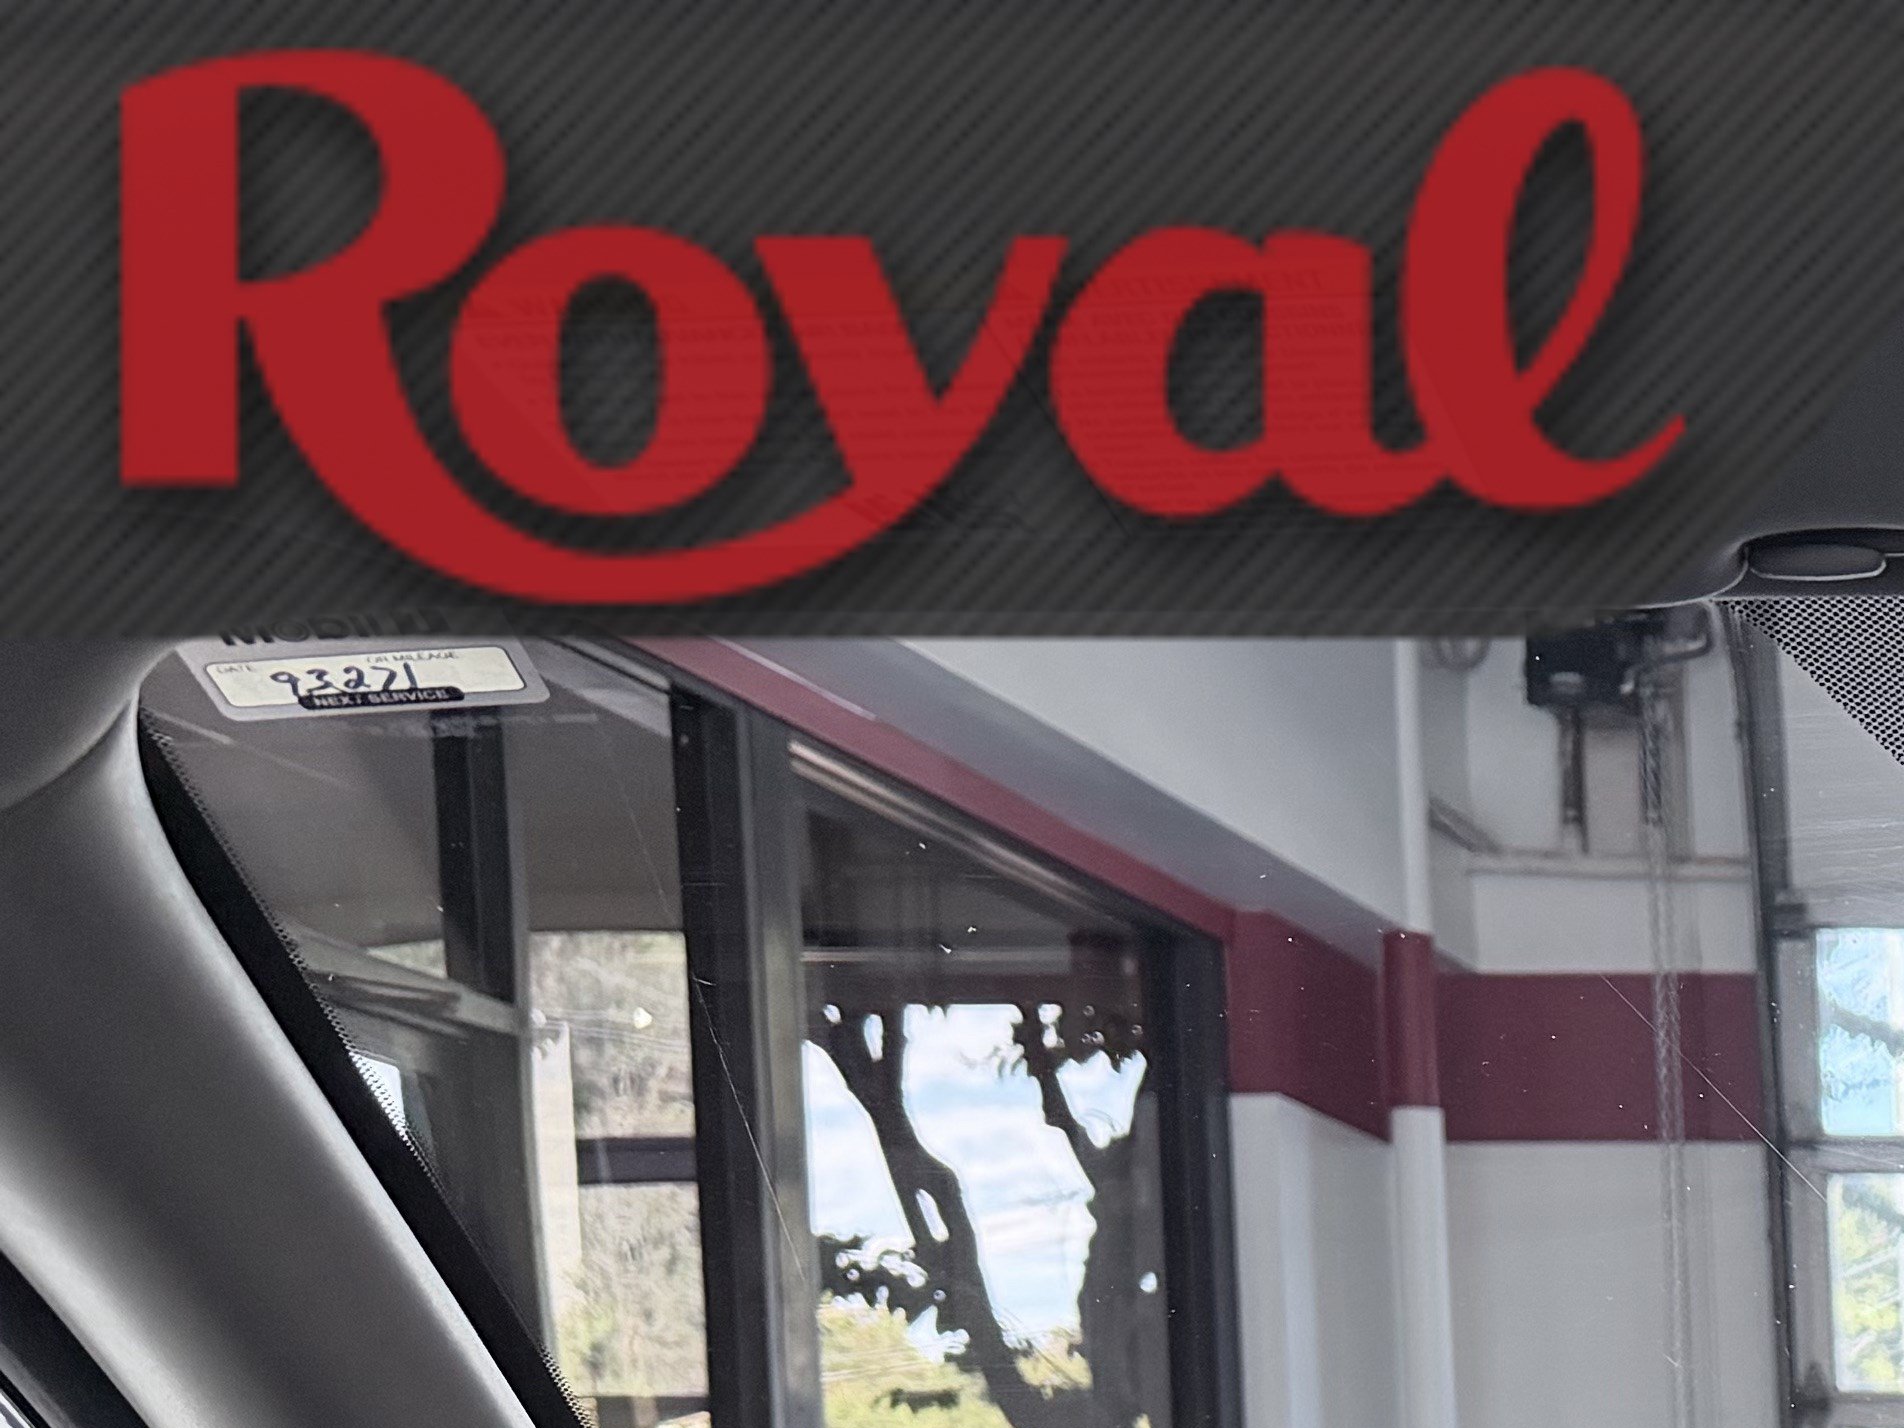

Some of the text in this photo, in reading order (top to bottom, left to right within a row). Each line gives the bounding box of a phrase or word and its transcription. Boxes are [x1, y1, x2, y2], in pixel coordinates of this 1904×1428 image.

[269, 662, 419, 698] 93271
[313, 688, 450, 707] NEXT SERVICE
